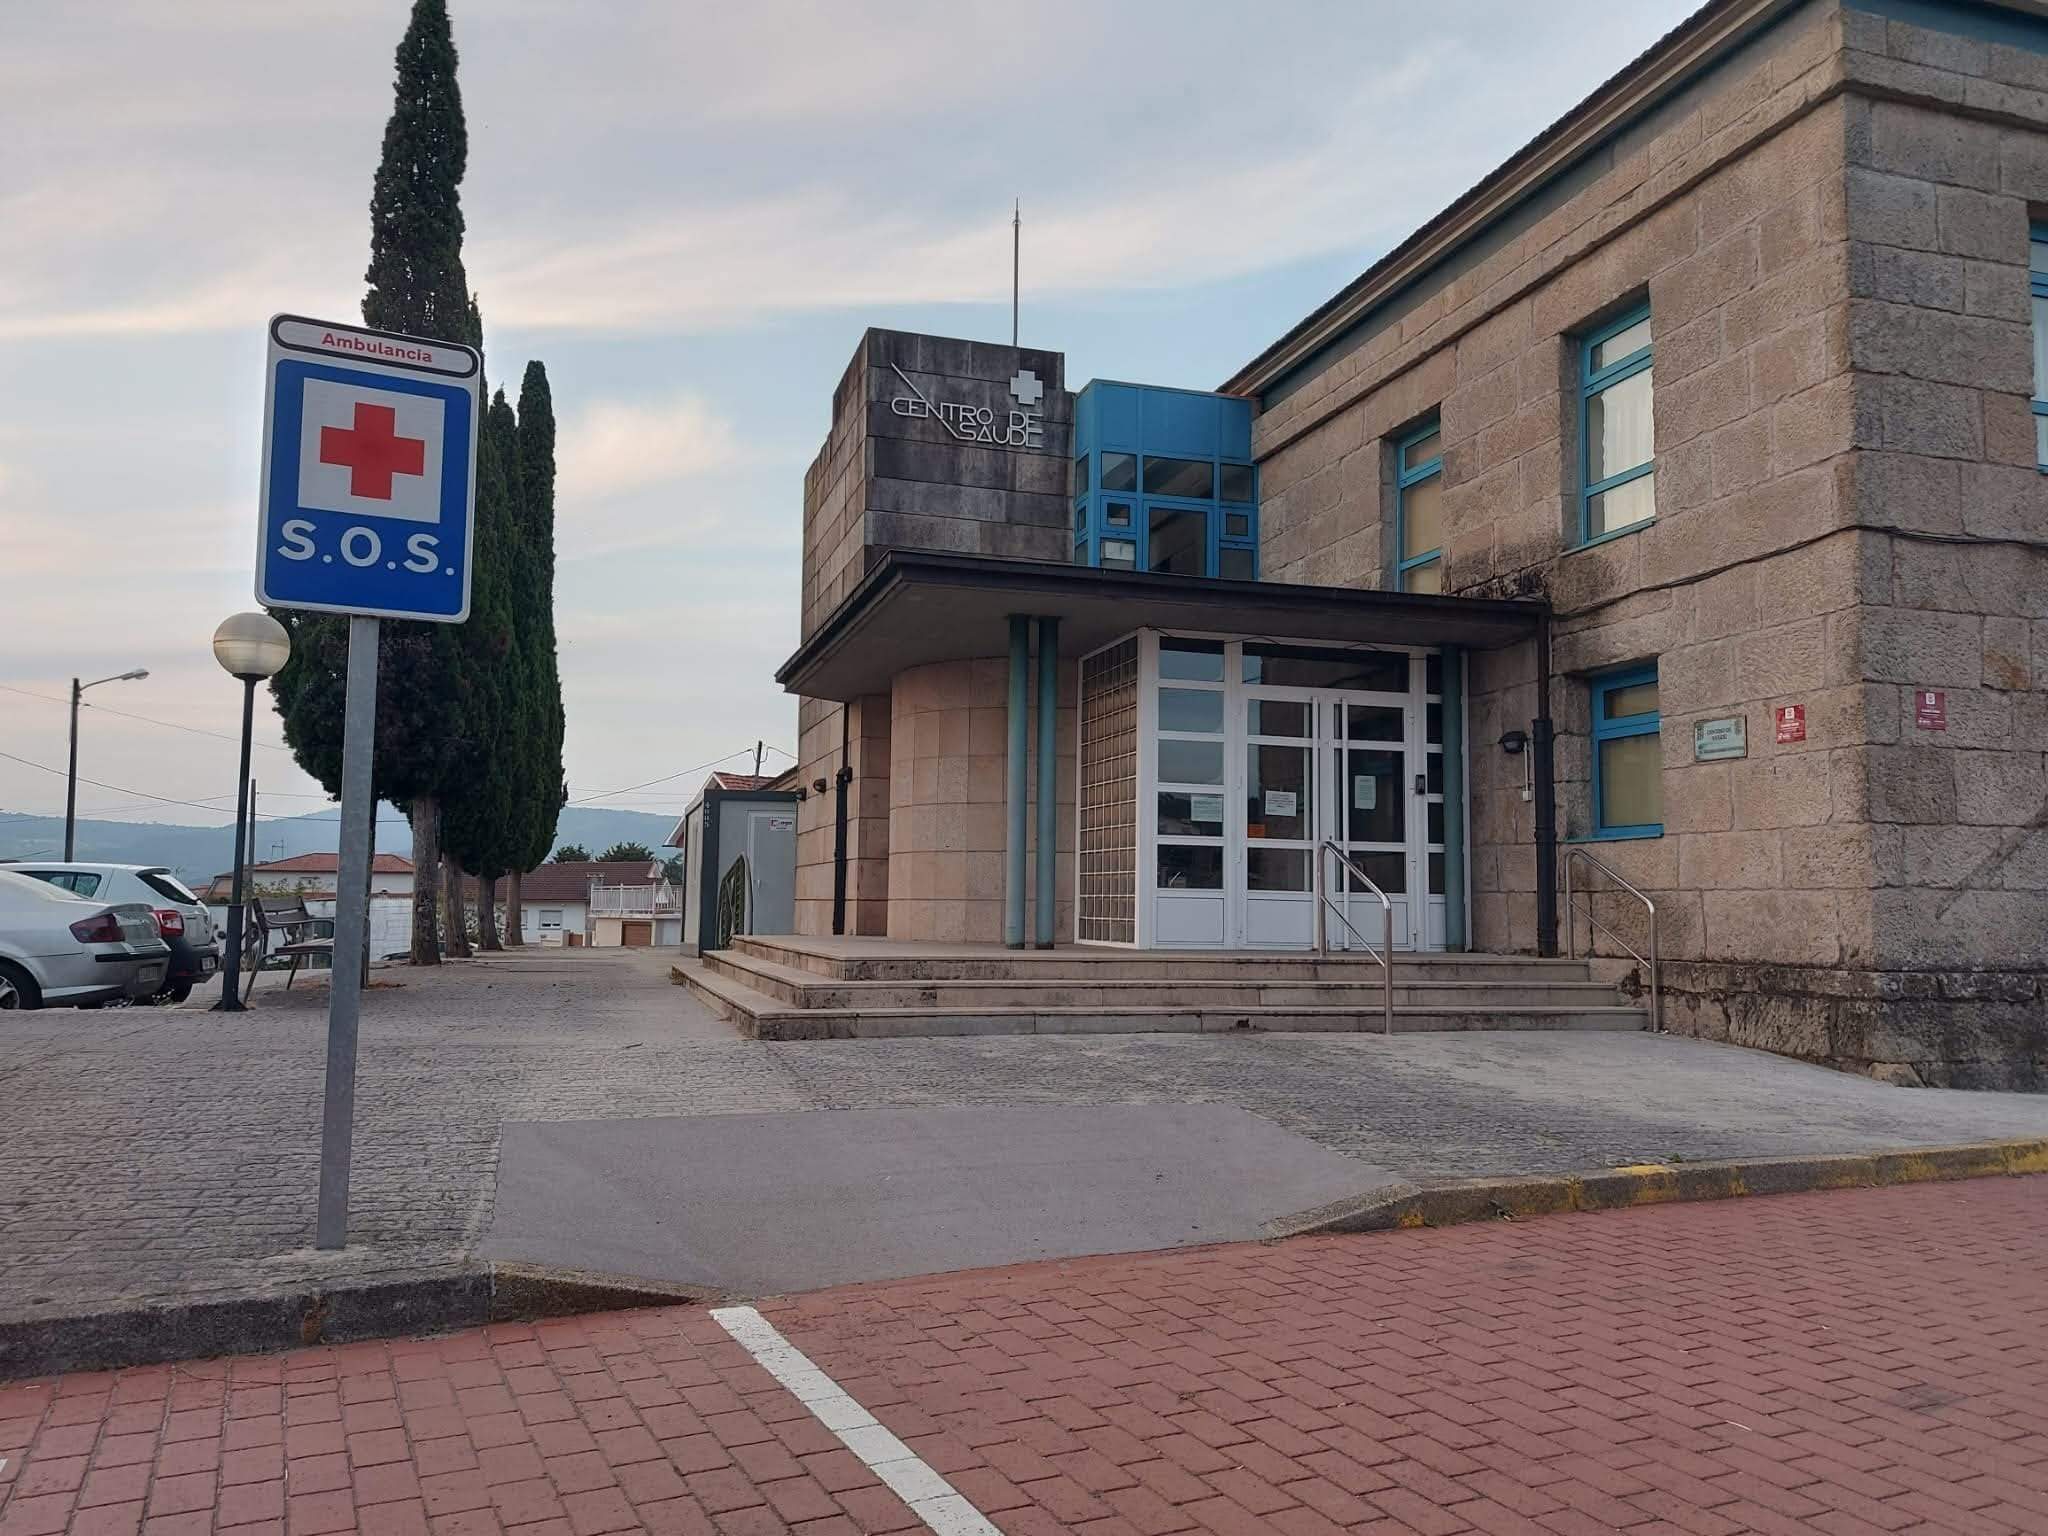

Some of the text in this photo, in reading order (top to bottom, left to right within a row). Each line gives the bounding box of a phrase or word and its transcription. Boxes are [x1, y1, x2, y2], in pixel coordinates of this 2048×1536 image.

[321, 333, 432, 362] Ambulancia
[891, 397, 1043, 431] CENTRO DE
[277, 519, 454, 576] S.O.S.
